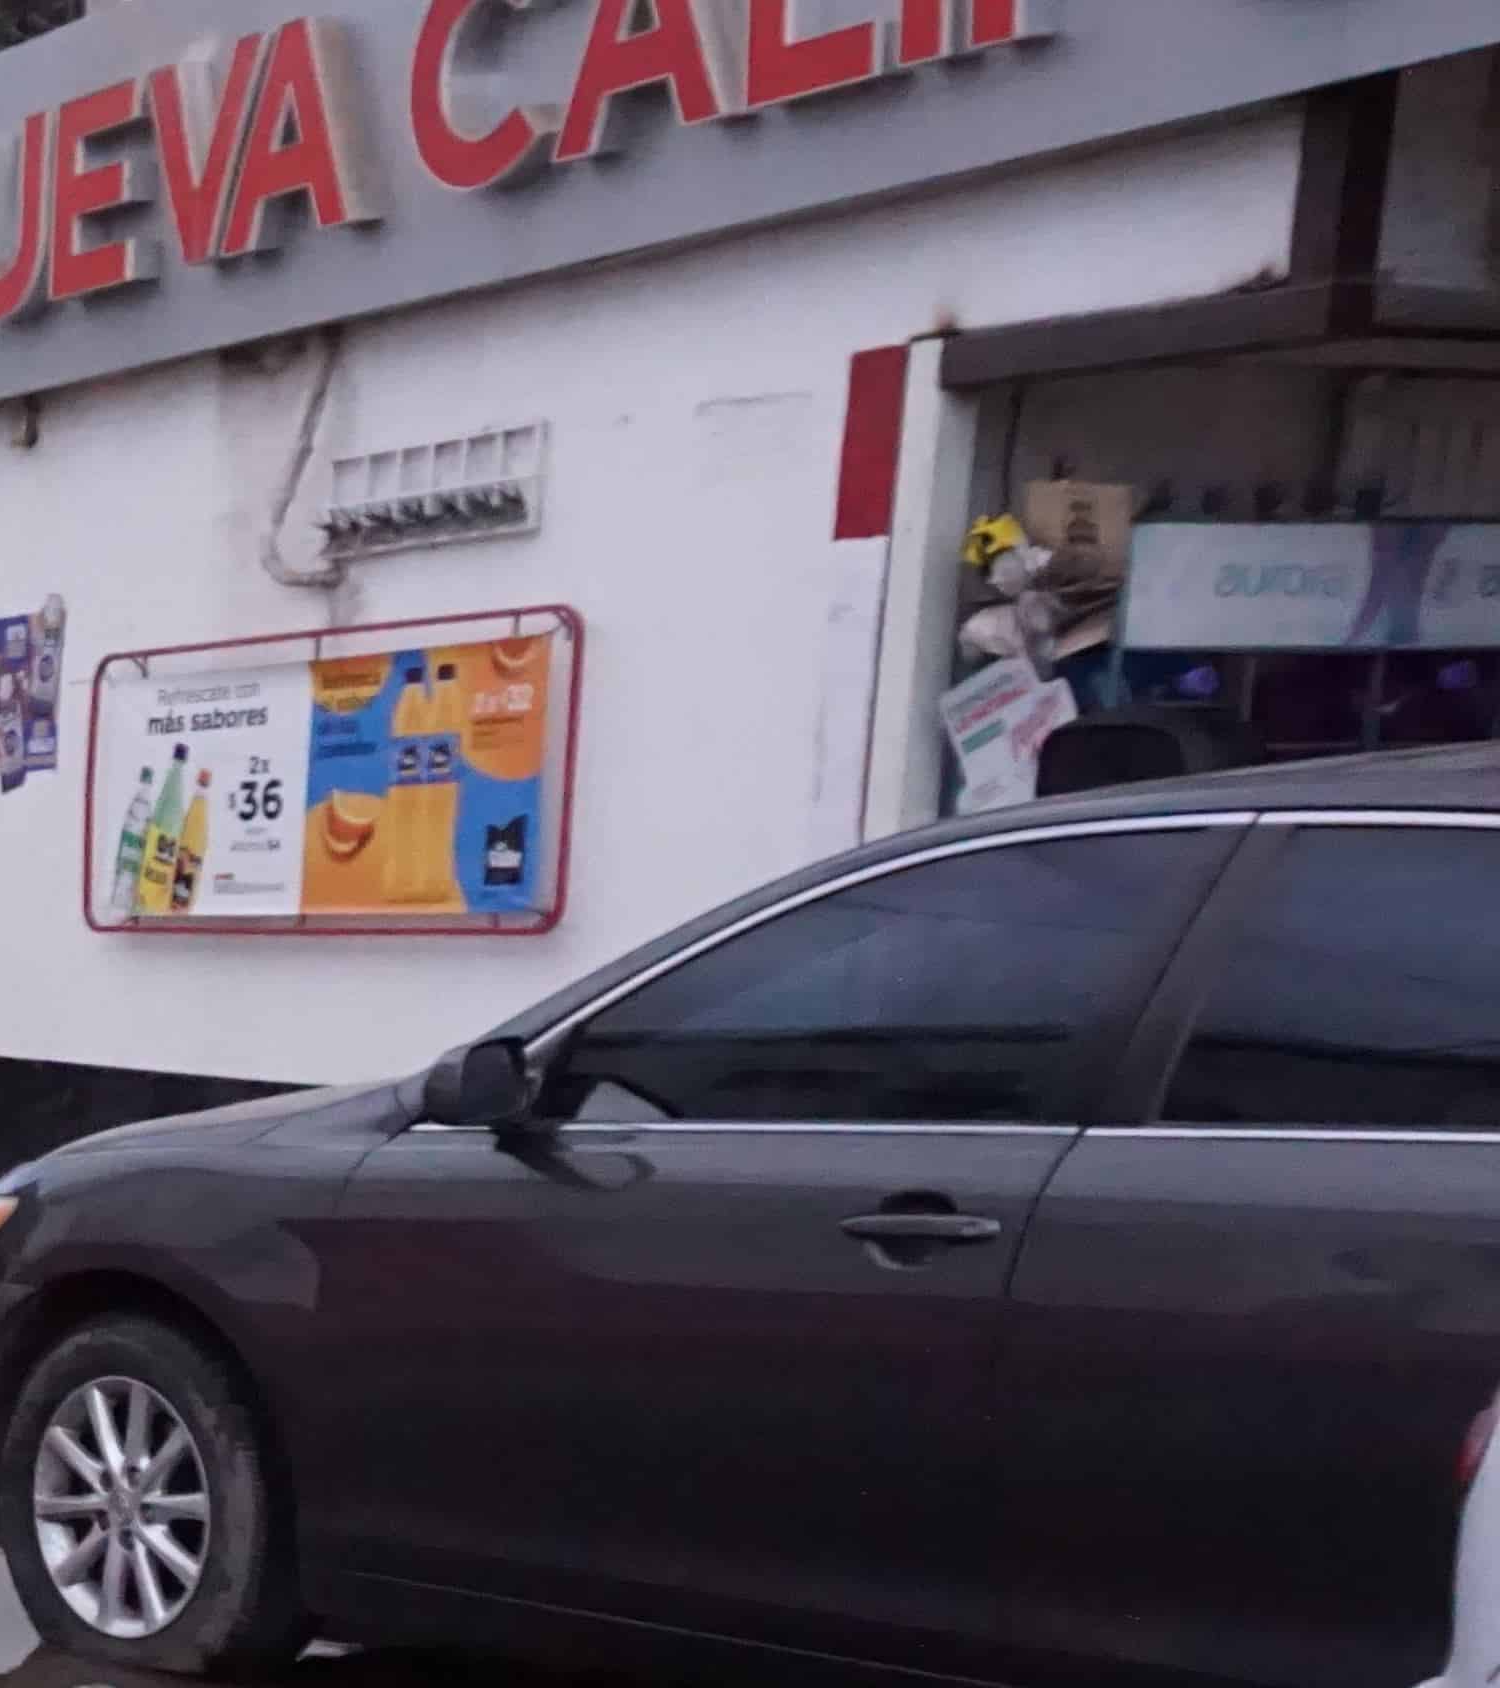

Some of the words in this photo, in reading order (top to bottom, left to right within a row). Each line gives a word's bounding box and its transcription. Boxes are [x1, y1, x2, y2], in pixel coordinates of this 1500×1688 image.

[148, 708, 185, 735] más
[190, 705, 269, 732] sabores
[249, 755, 270, 775] 2x
